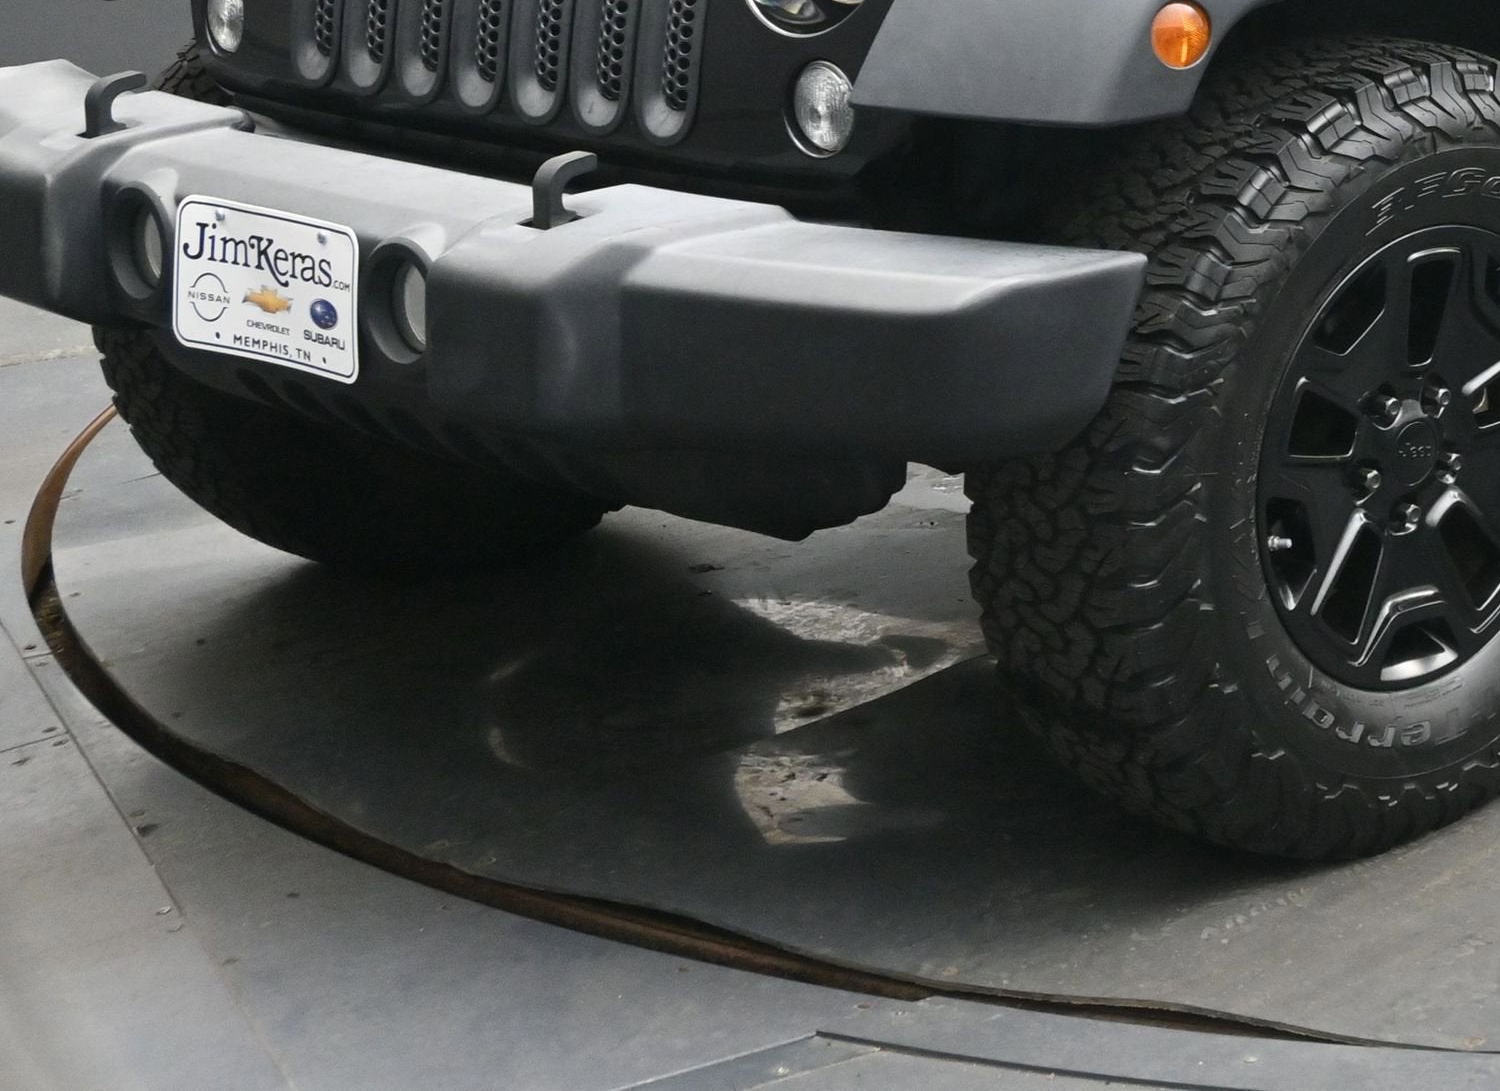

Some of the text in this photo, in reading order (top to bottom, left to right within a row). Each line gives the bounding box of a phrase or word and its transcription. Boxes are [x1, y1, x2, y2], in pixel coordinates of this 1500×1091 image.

[187, 290, 231, 305] NISSAN
[246, 319, 290, 336] CHEVROLET
[233, 333, 312, 362] MEMPHIS, TN
[303, 329, 346, 351] SUBARU
